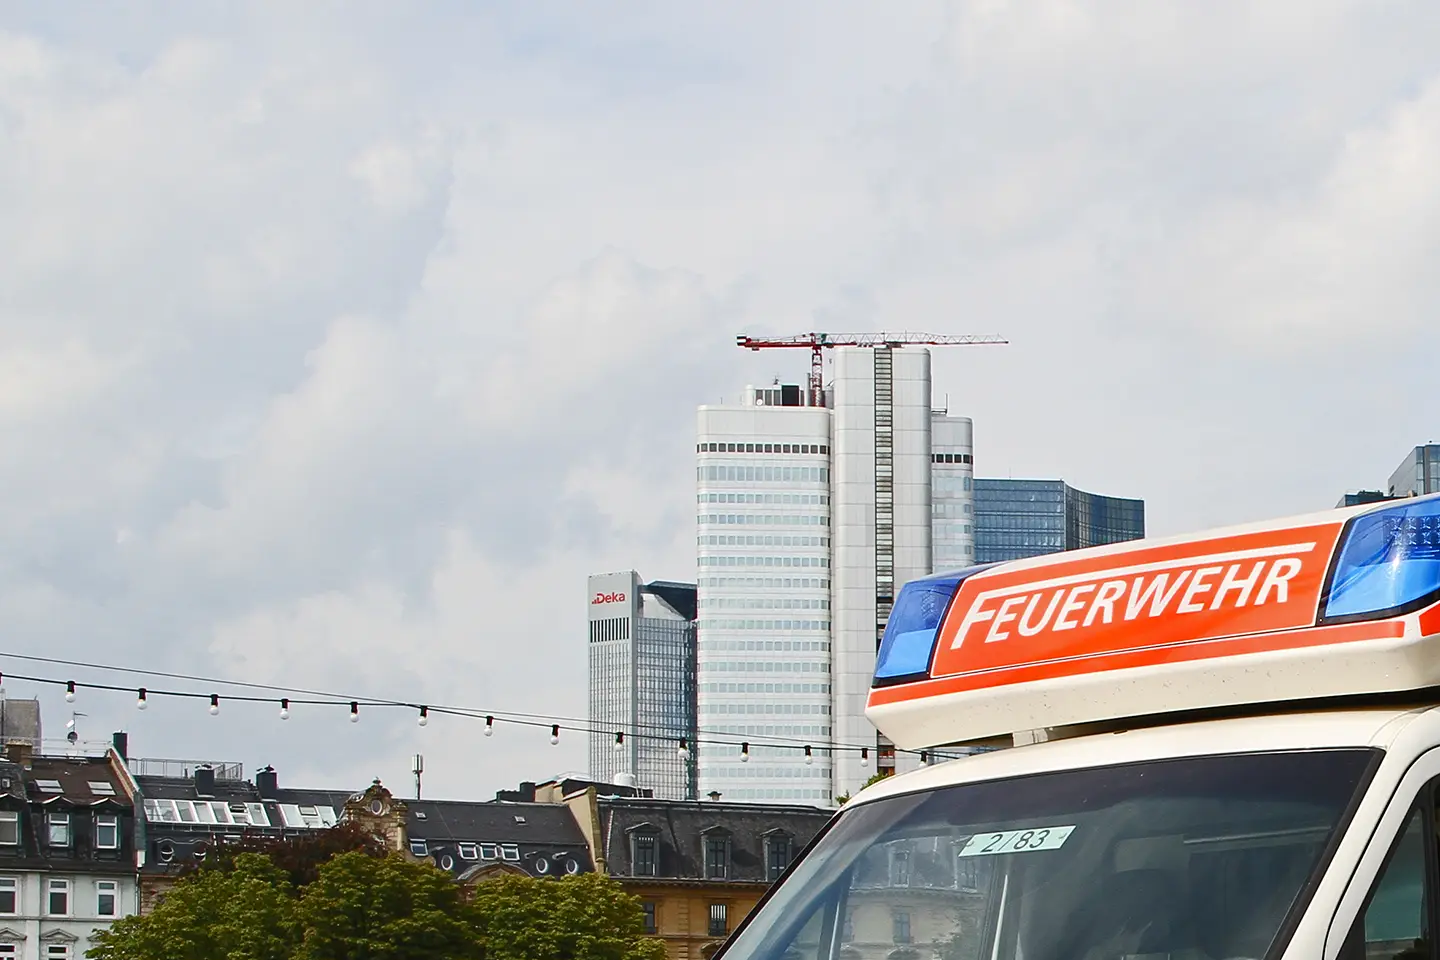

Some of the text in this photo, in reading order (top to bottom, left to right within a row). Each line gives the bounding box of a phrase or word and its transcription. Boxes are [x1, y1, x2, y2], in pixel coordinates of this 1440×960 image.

[596, 592, 625, 604] Deka
[950, 542, 1316, 650] FEUERWEHR
[980, 829, 1050, 852] 2/83
